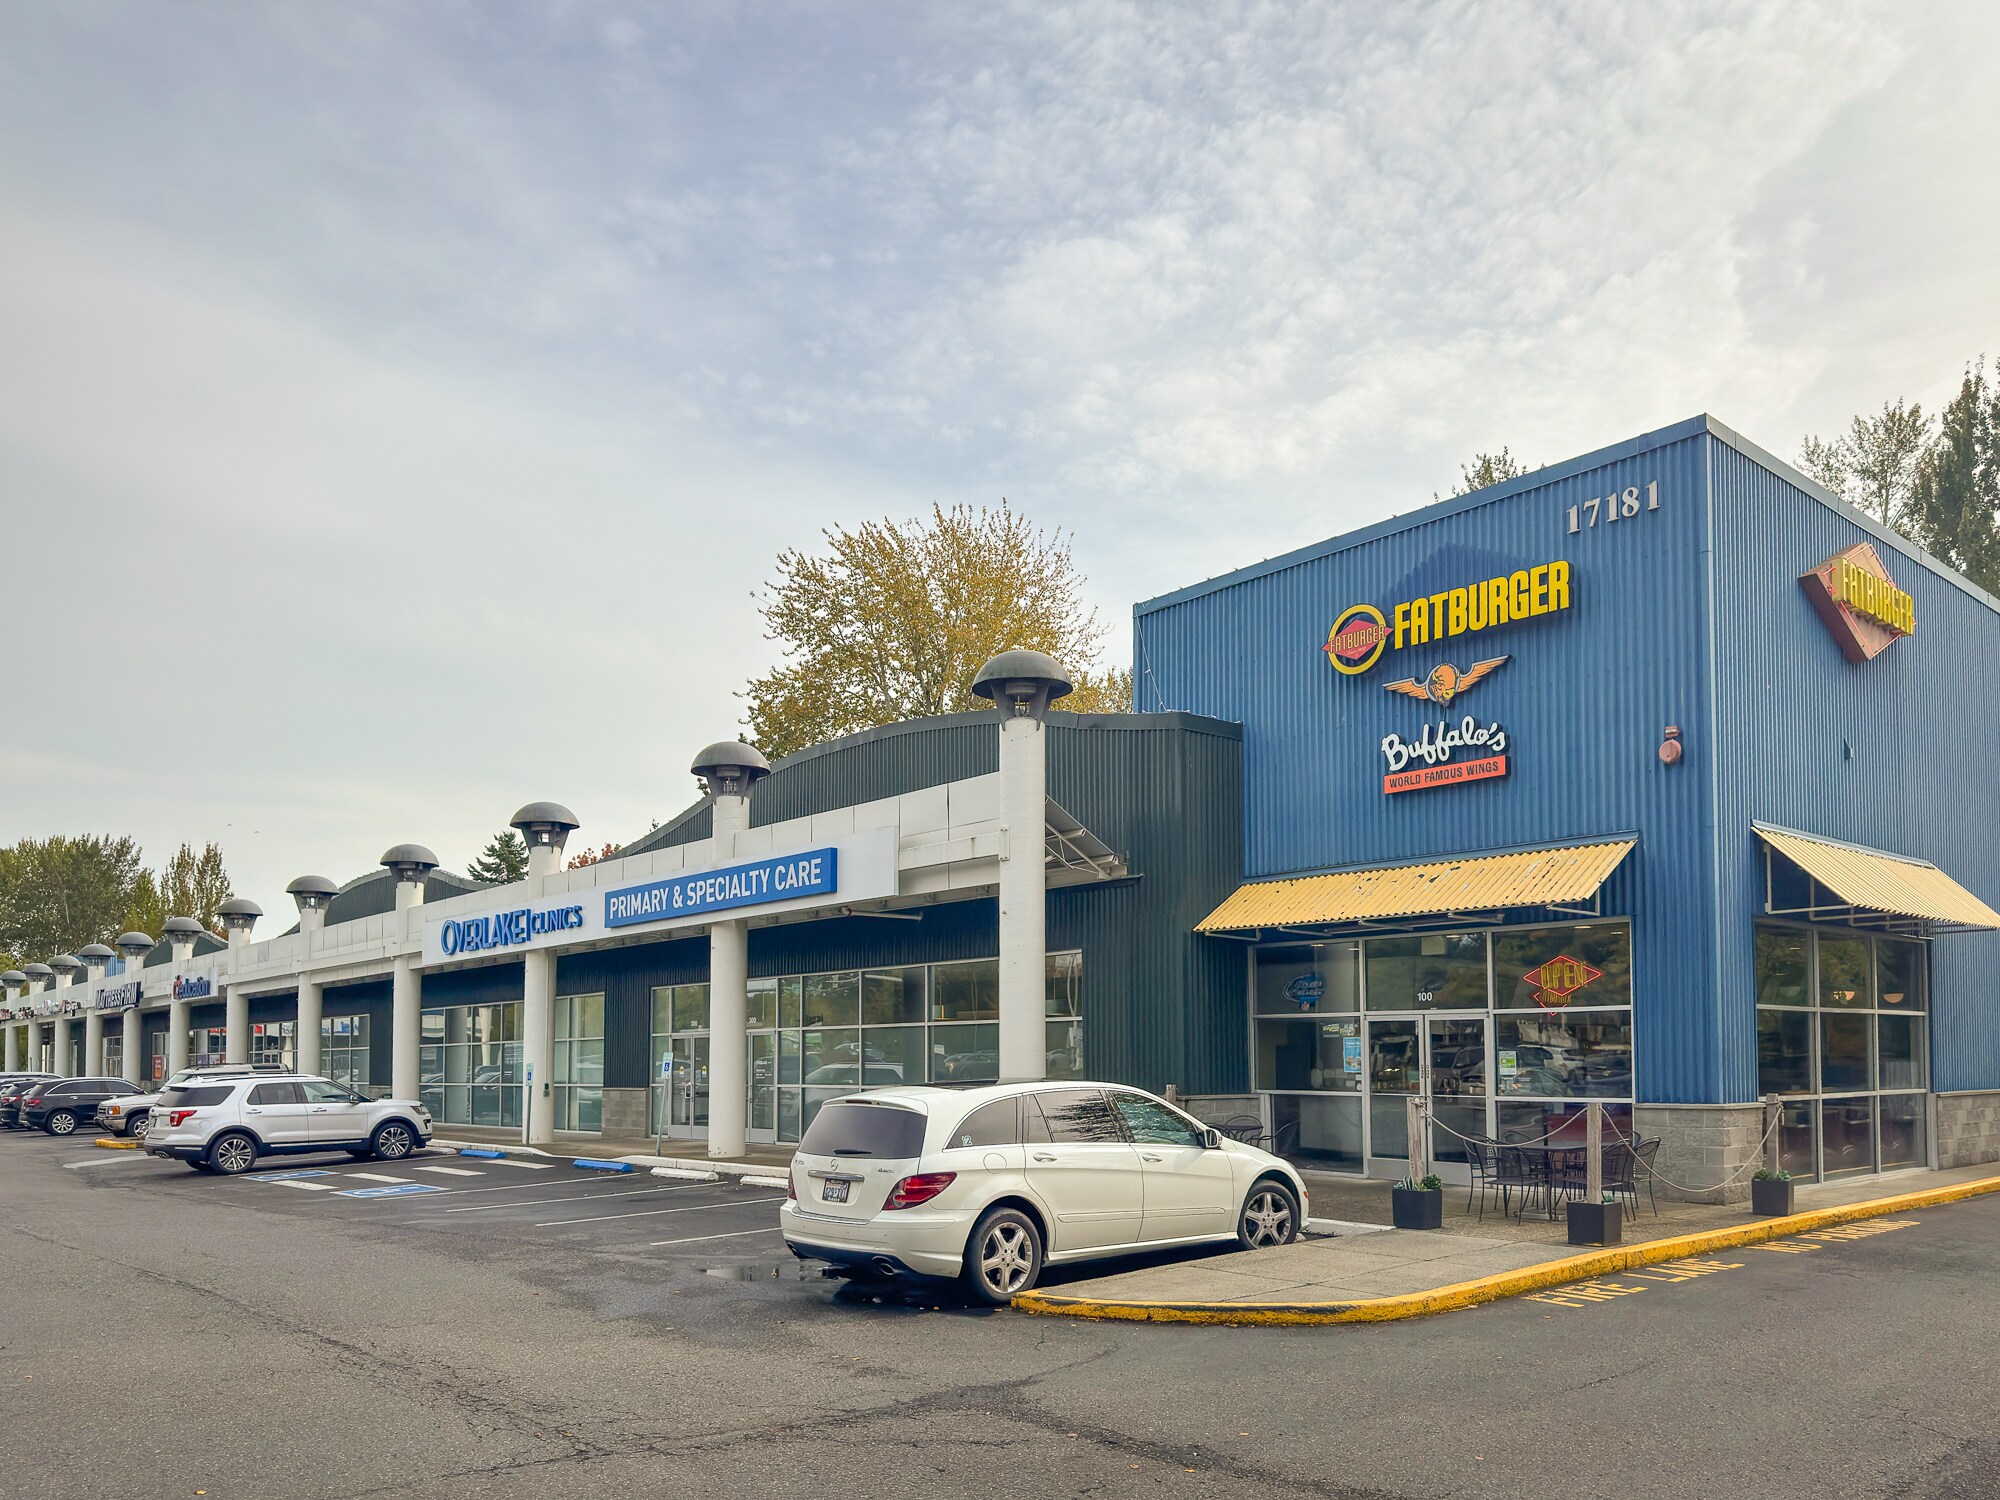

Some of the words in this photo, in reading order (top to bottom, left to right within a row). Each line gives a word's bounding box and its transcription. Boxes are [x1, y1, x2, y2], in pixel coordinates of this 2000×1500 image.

[1566, 480, 1661, 535] 17181
[1394, 559, 1570, 650] FATBURGER
[1840, 557, 1914, 636] FATBURGER
[1329, 624, 1385, 654] FATBURGER
[1381, 715, 1506, 772] Buffalo's
[1389, 773, 1421, 789] WORLD
[1424, 767, 1463, 783] FAMOUS
[1466, 761, 1499, 776] WINGS
[609, 887, 669, 919] PRIMARY
[673, 885, 683, 908] &
[687, 867, 771, 906] SPECIALTY
[774, 858, 822, 891] CARE
[441, 910, 526, 955] OVERLAKE
[531, 905, 583, 934] CLINICS
[1417, 991, 1433, 1002] 100
[1541, 962, 1586, 989] OPEN
[961, 1134, 973, 1146] 12
[1521, 1276, 1648, 1308] FIRE
[1621, 1258, 1745, 1283] LANE
